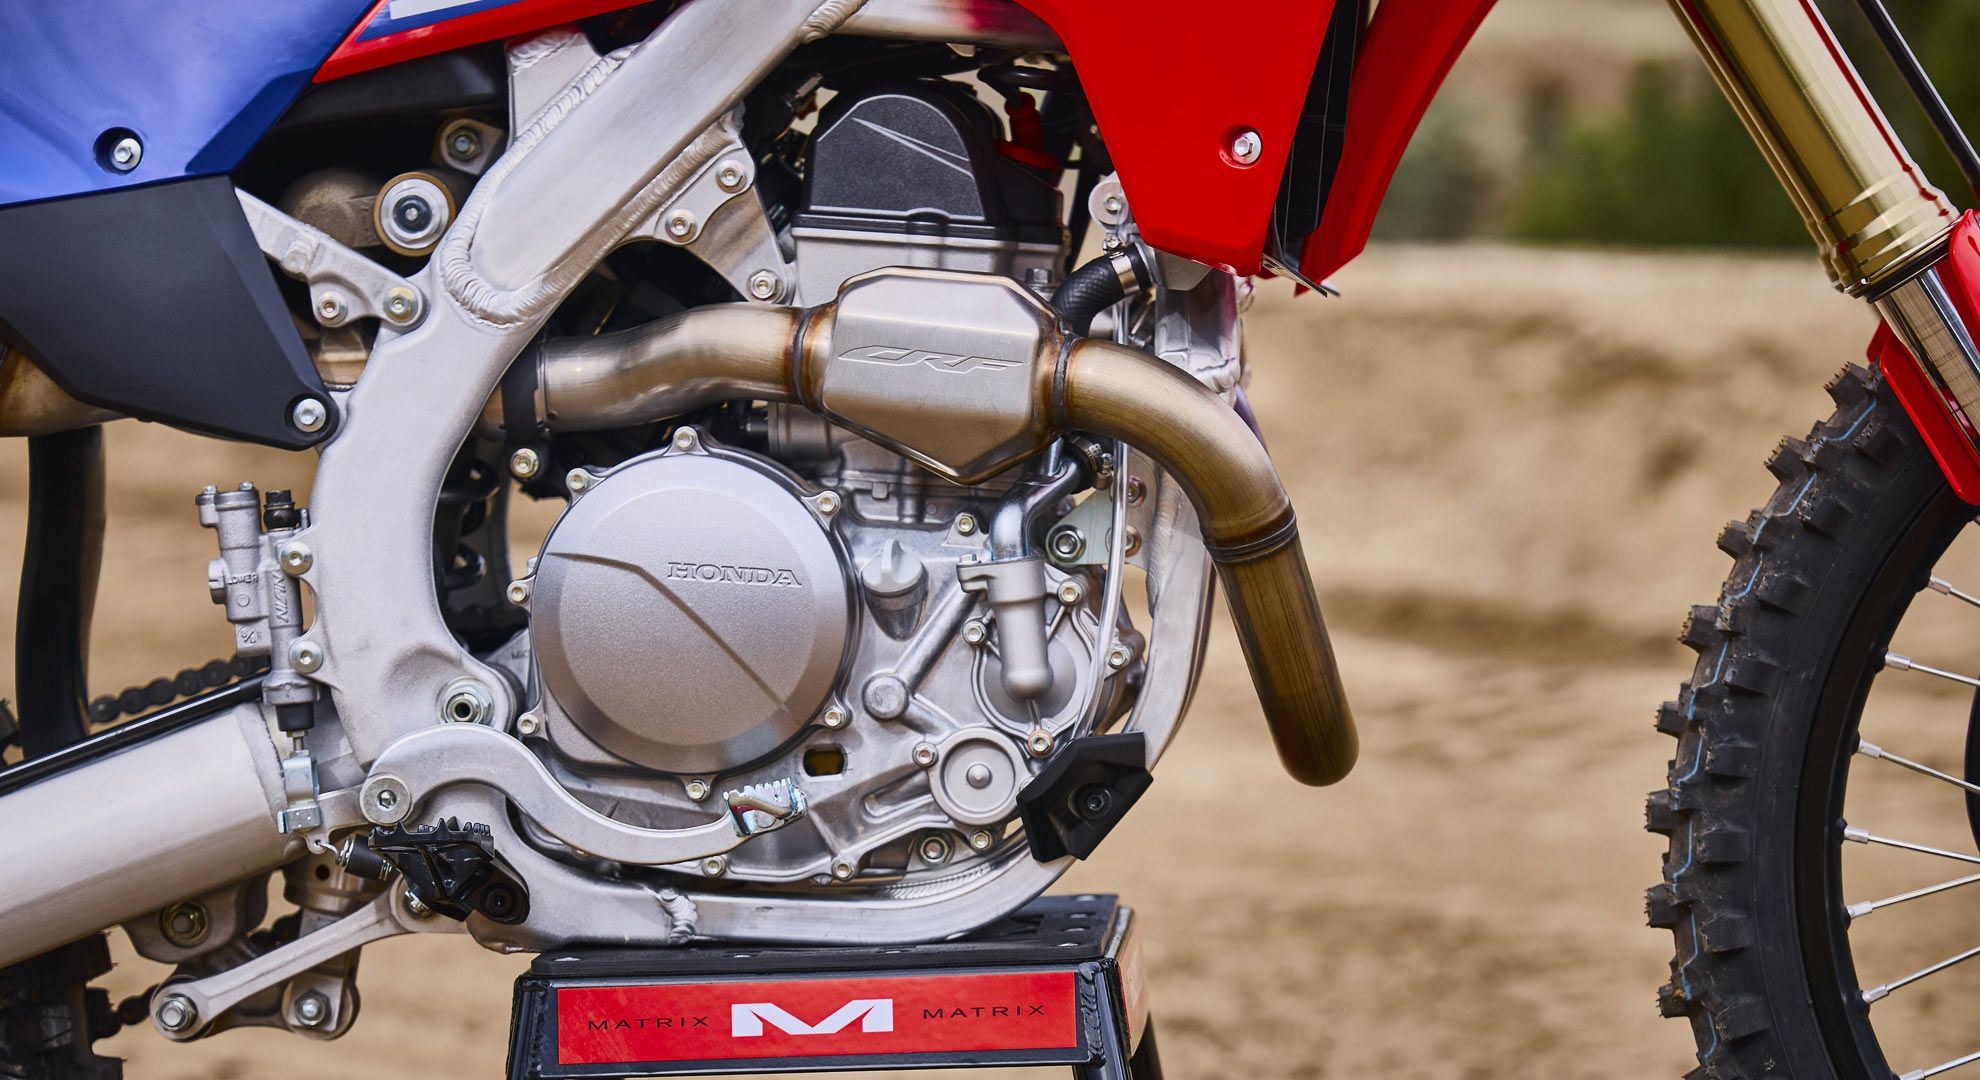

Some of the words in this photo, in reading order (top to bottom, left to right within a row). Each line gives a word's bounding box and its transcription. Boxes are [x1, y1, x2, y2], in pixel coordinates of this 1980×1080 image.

[839, 345, 1024, 374] CRF
[227, 573, 259, 585] LOWER
[667, 561, 802, 588] HONDA
[588, 1016, 709, 1031] MATRIX
[923, 1005, 1045, 1020] MATRIX
